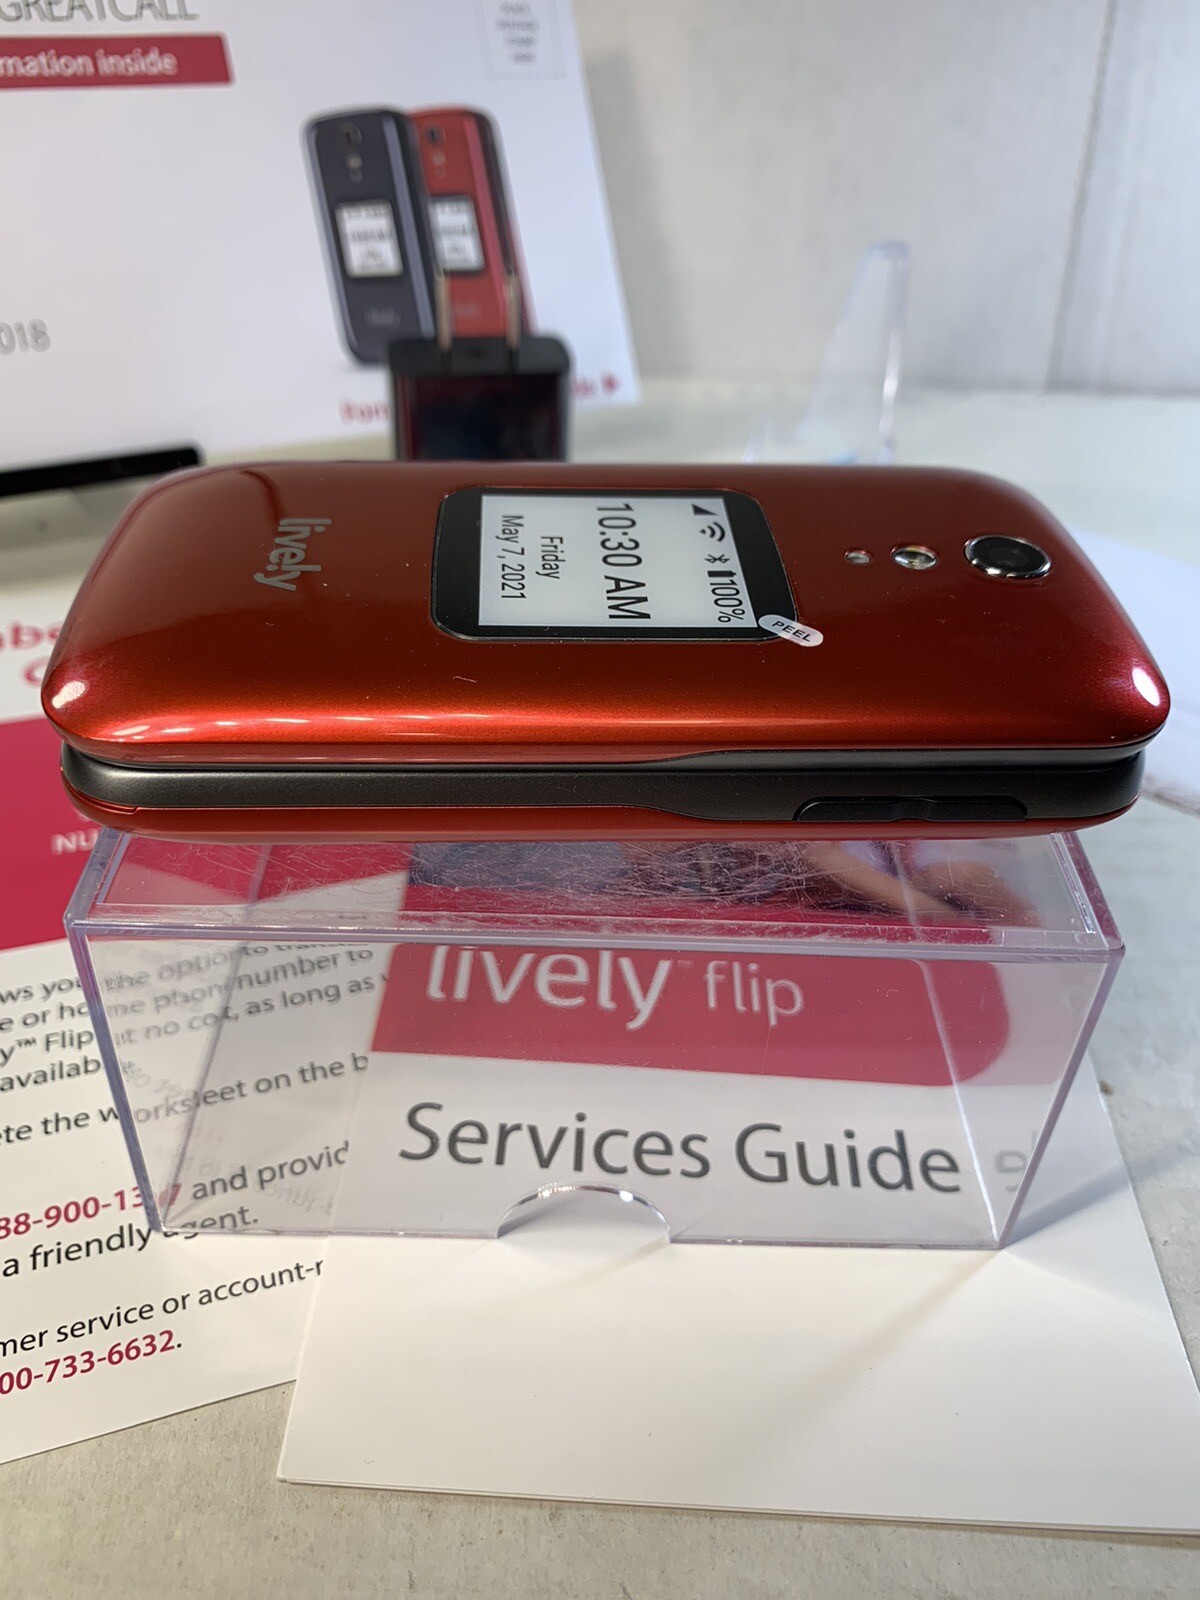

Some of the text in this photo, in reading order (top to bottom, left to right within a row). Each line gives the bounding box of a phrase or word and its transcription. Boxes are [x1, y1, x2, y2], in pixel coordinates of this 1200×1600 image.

[95, 47, 178, 75] inside
[254, 518, 332, 592] lively
[496, 515, 524, 543] May
[501, 563, 526, 599] 2021
[535, 536, 566, 579] Friday
[597, 503, 651, 619] 10:30 AM
[709, 579, 744, 623] 100%
[772, 620, 811, 642] PEEL
[22, 1008, 51, 1028] or
[237, 953, 341, 989] number
[45, 1029, 95, 1052] Flip
[246, 998, 275, 1014] as
[281, 989, 342, 1008] long
[348, 976, 375, 993] as
[704, 959, 804, 1027] flip
[40, 1112, 91, 1136] the
[255, 1073, 292, 1095] on
[298, 1061, 345, 1084] the
[399, 1101, 711, 1178] Services
[734, 1121, 961, 1193] Guide
[192, 1165, 248, 1200] and
[2, 1257, 20, 1277] a
[30, 1222, 152, 1272] friendly
[56, 1302, 155, 1343] service
[162, 1291, 191, 1314] or
